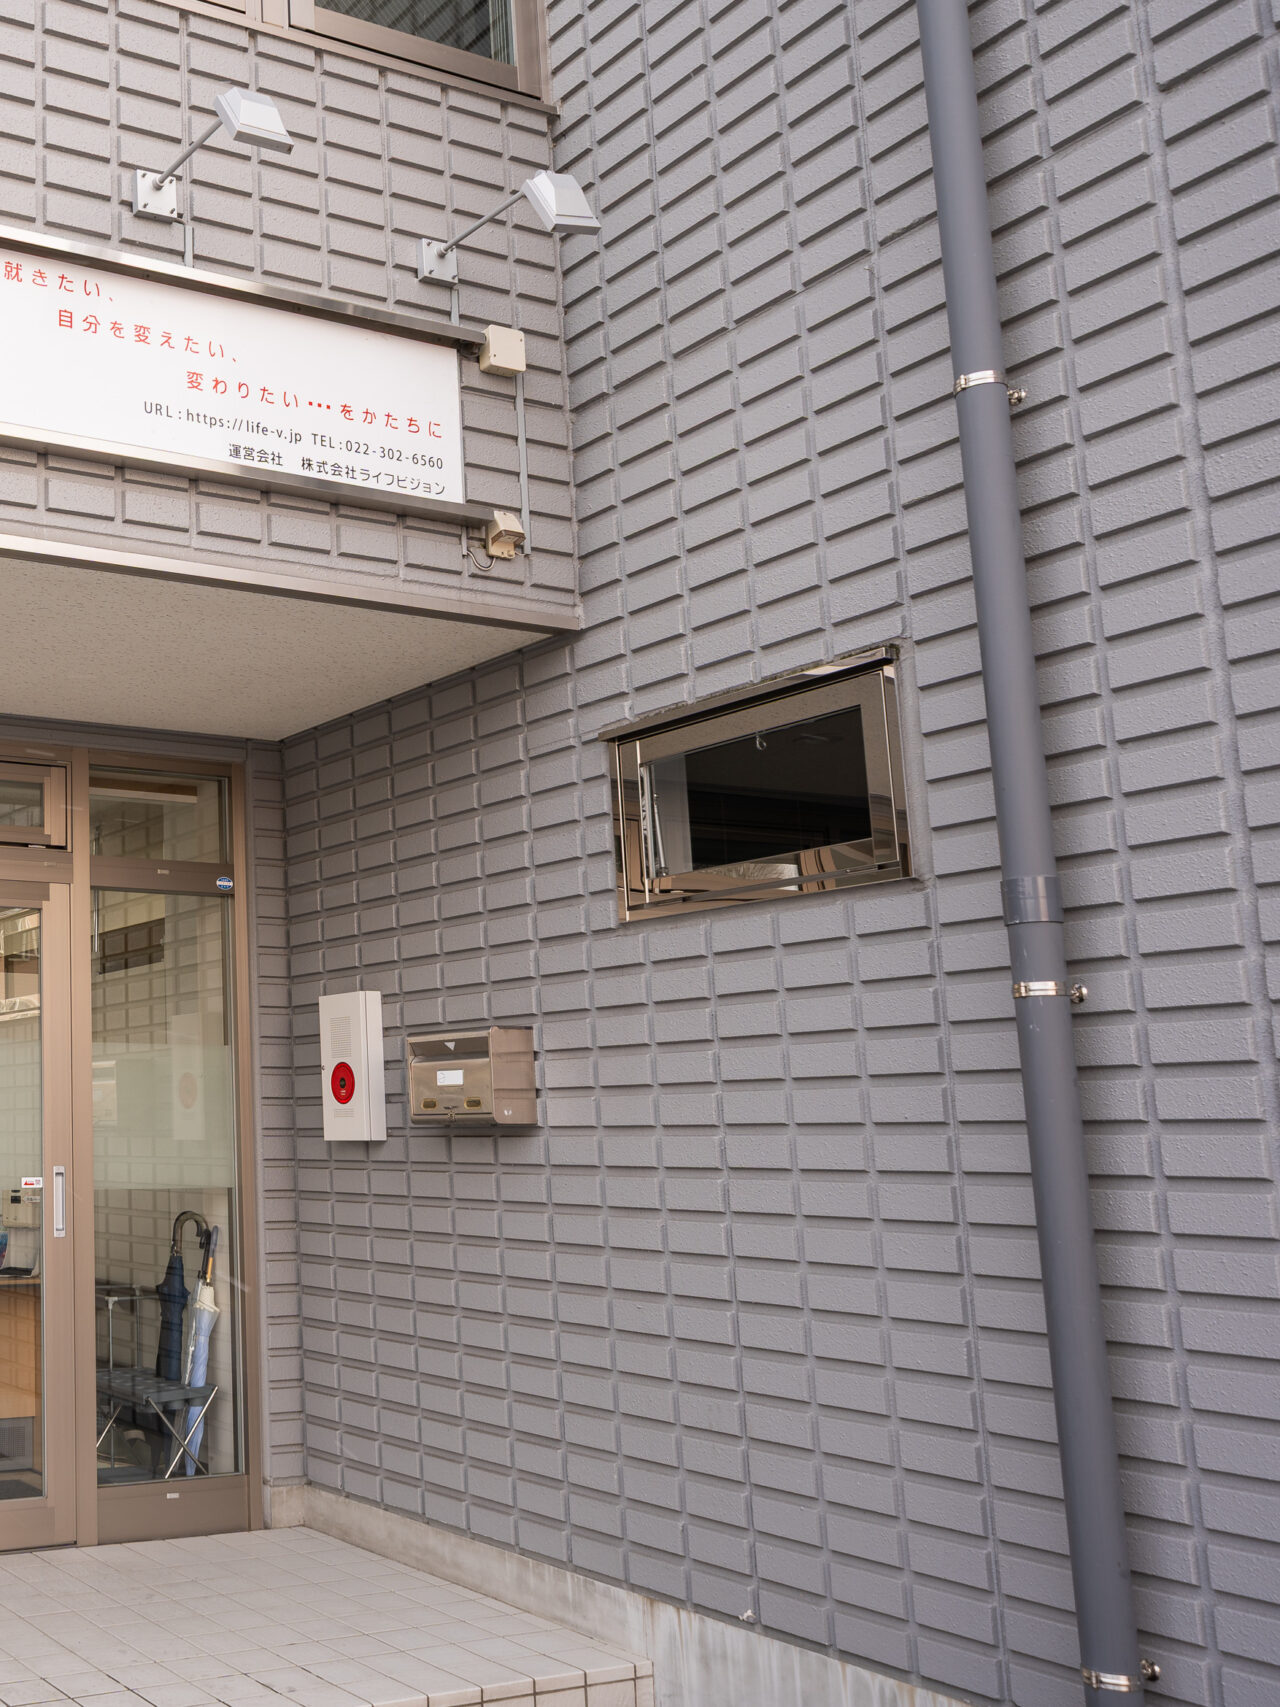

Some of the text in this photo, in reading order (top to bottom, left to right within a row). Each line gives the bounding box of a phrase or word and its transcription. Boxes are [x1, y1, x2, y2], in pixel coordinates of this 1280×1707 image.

[229, 443, 445, 495] 運営会社 株式会社ライフビジョン
[311, 433, 443, 470] TEL:022-302-6560
